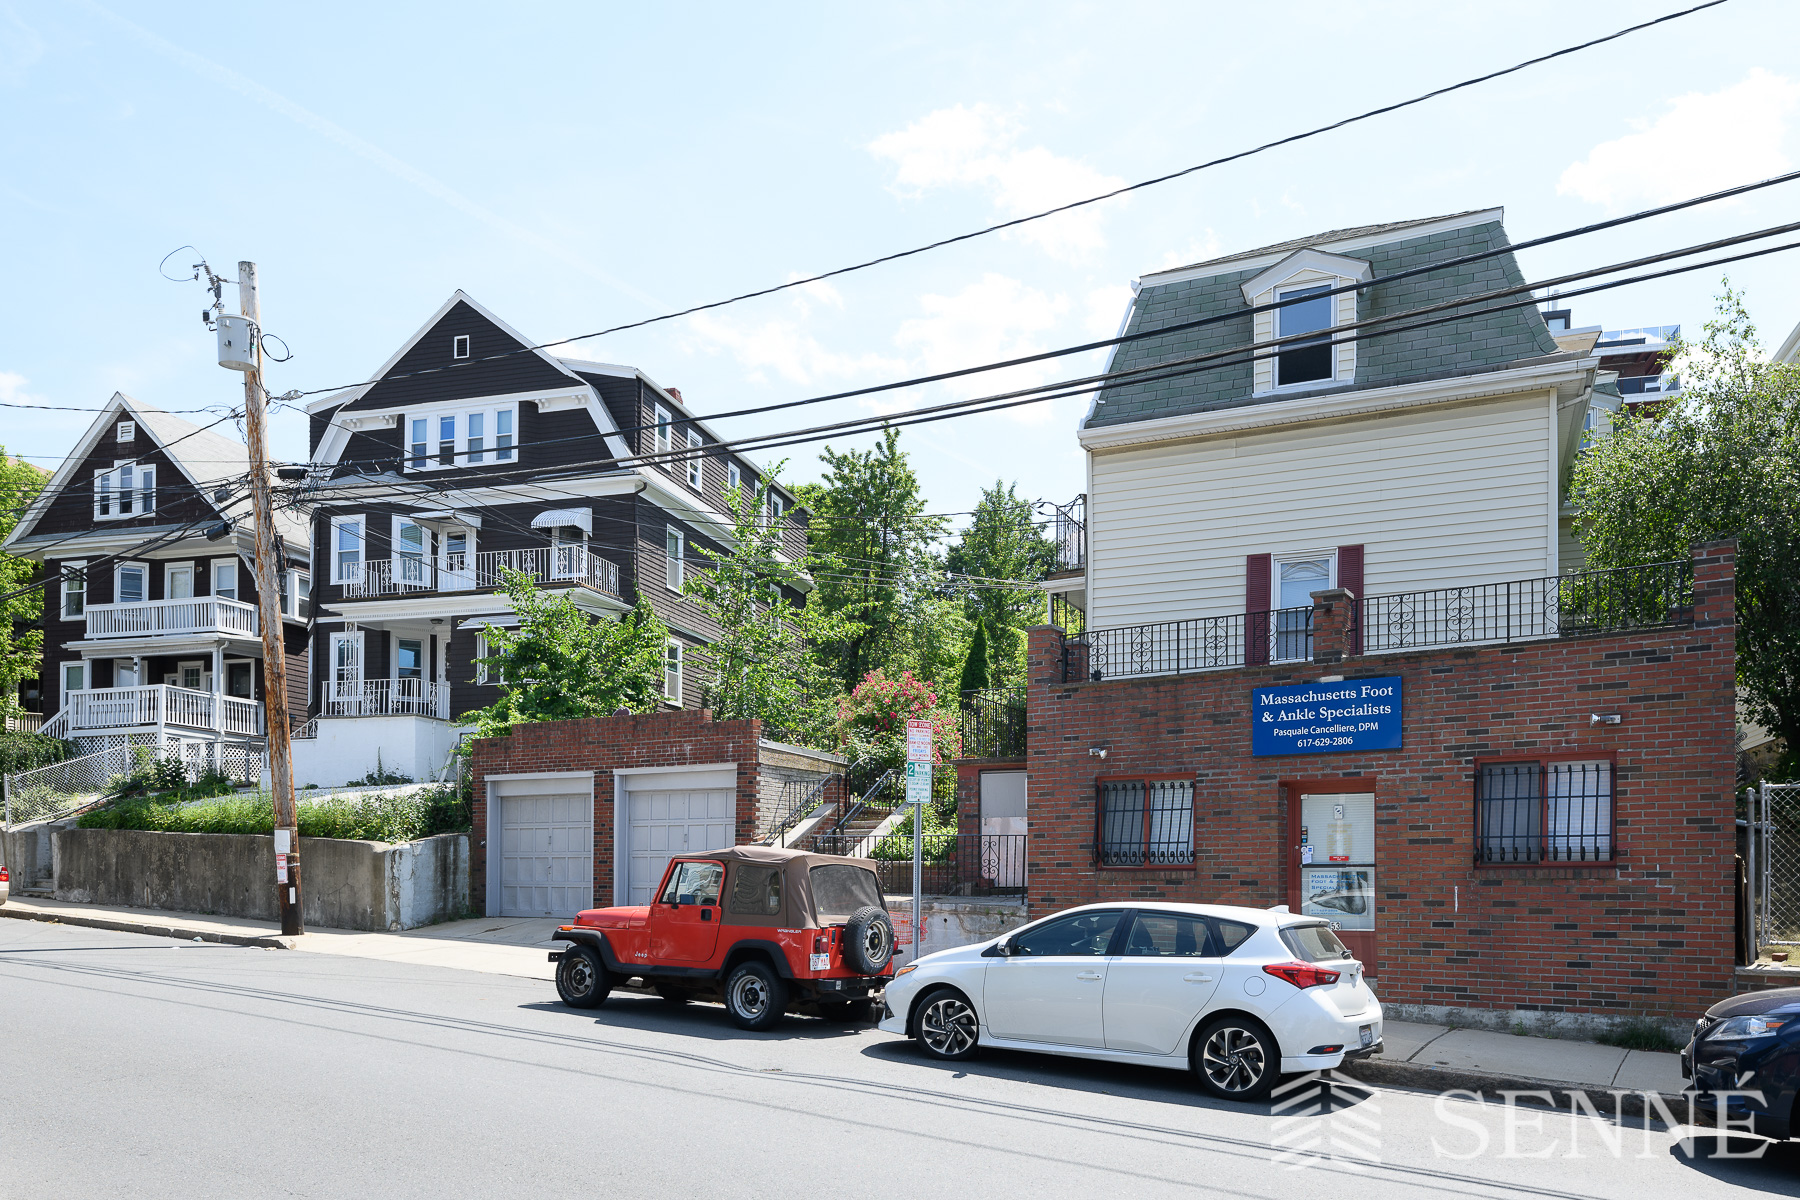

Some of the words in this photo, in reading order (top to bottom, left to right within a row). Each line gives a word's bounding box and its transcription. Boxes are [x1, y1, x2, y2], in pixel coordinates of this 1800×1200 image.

[1260, 690, 1357, 706] Massachusetts
[1360, 686, 1394, 698] Foot
[1262, 712, 1274, 722] &
[1277, 708, 1316, 722] Ankle
[1320, 704, 1392, 722] Specialists
[1274, 726, 1308, 738] Pasquale
[1310, 724, 1357, 735] Cancelliere,
[1358, 722, 1378, 732] DPM
[1297, 736, 1353, 747] 617-629-2806
[908, 764, 914, 775] 2
[1331, 922, 1340, 930] 53
[634, 950, 647, 959] Jeep
